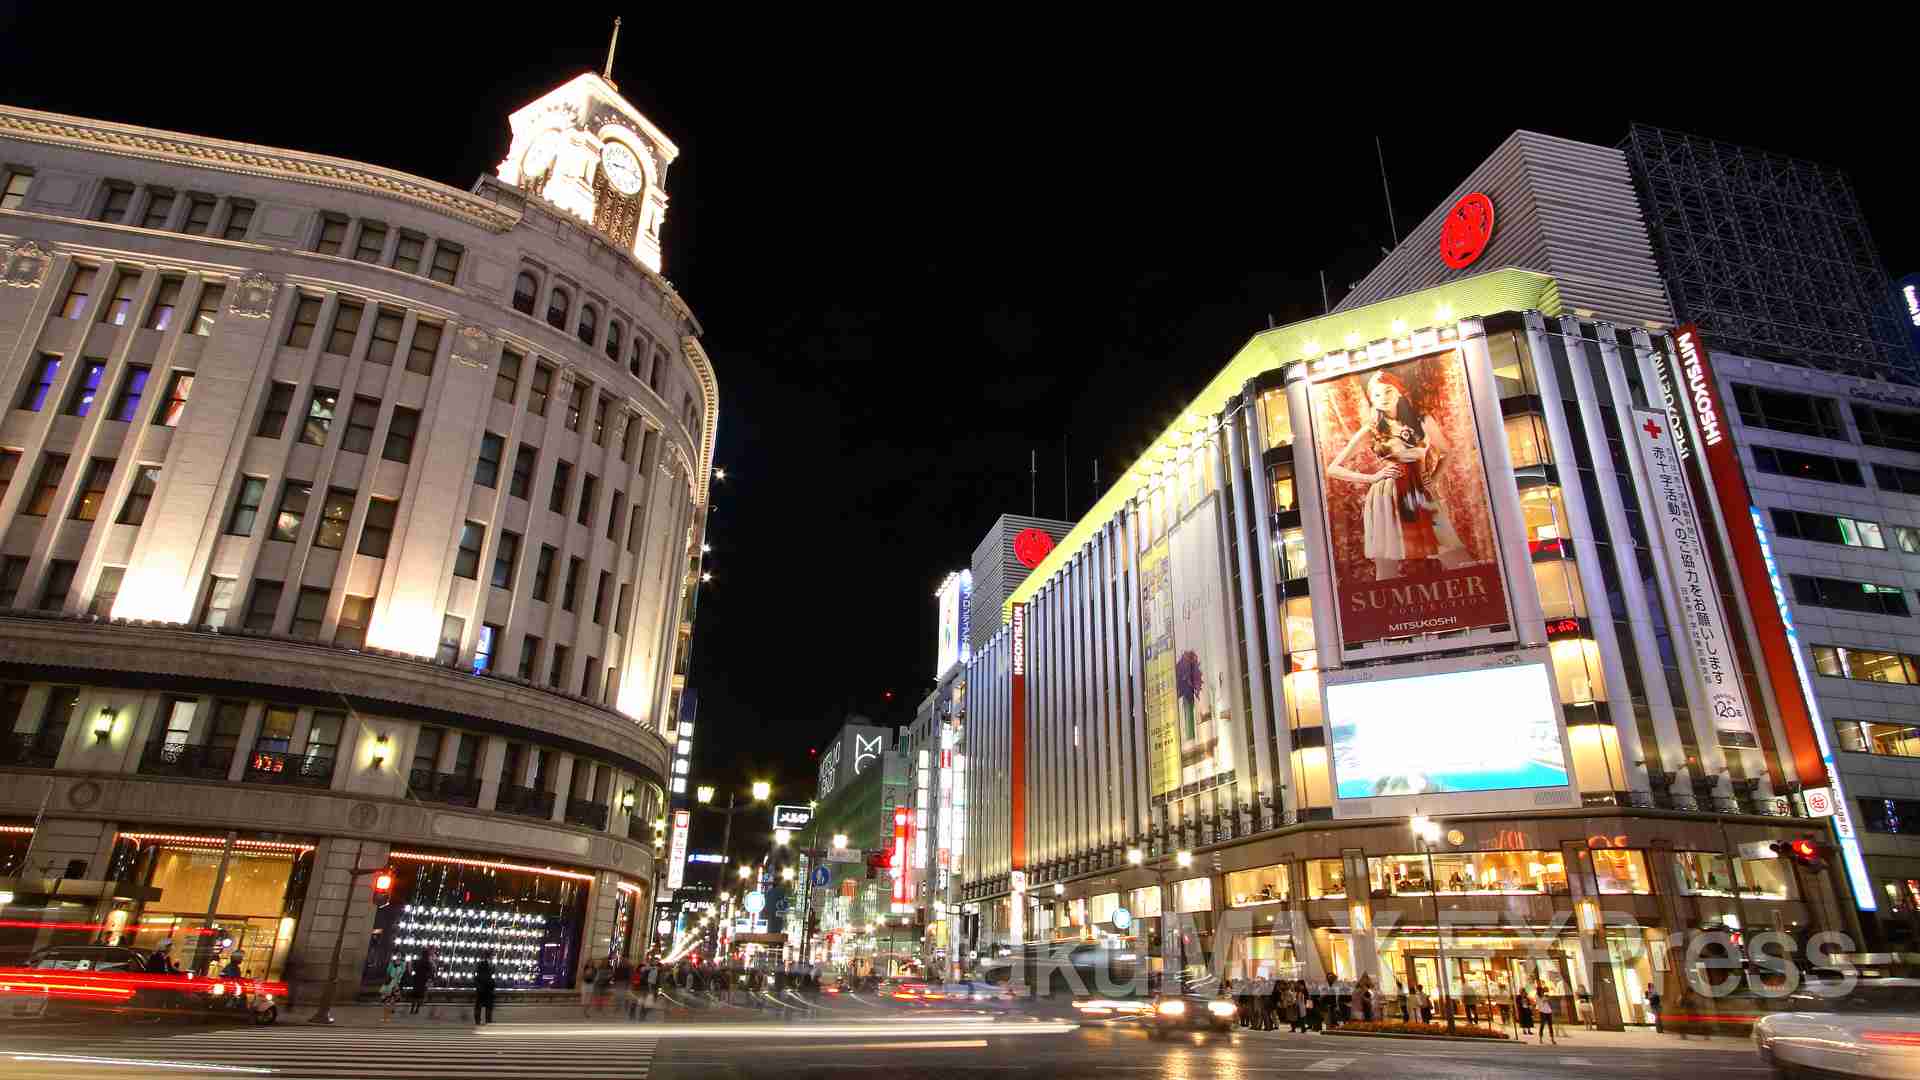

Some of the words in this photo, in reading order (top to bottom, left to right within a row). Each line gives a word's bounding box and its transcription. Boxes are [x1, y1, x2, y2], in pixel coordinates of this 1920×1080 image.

[1677, 332, 1722, 446] MITSUKOSHI
[1351, 575, 1488, 612] SUMMER
[1013, 606, 1025, 676] MITSUKOSHI
[1388, 615, 1457, 633] MITSUKOSHI
